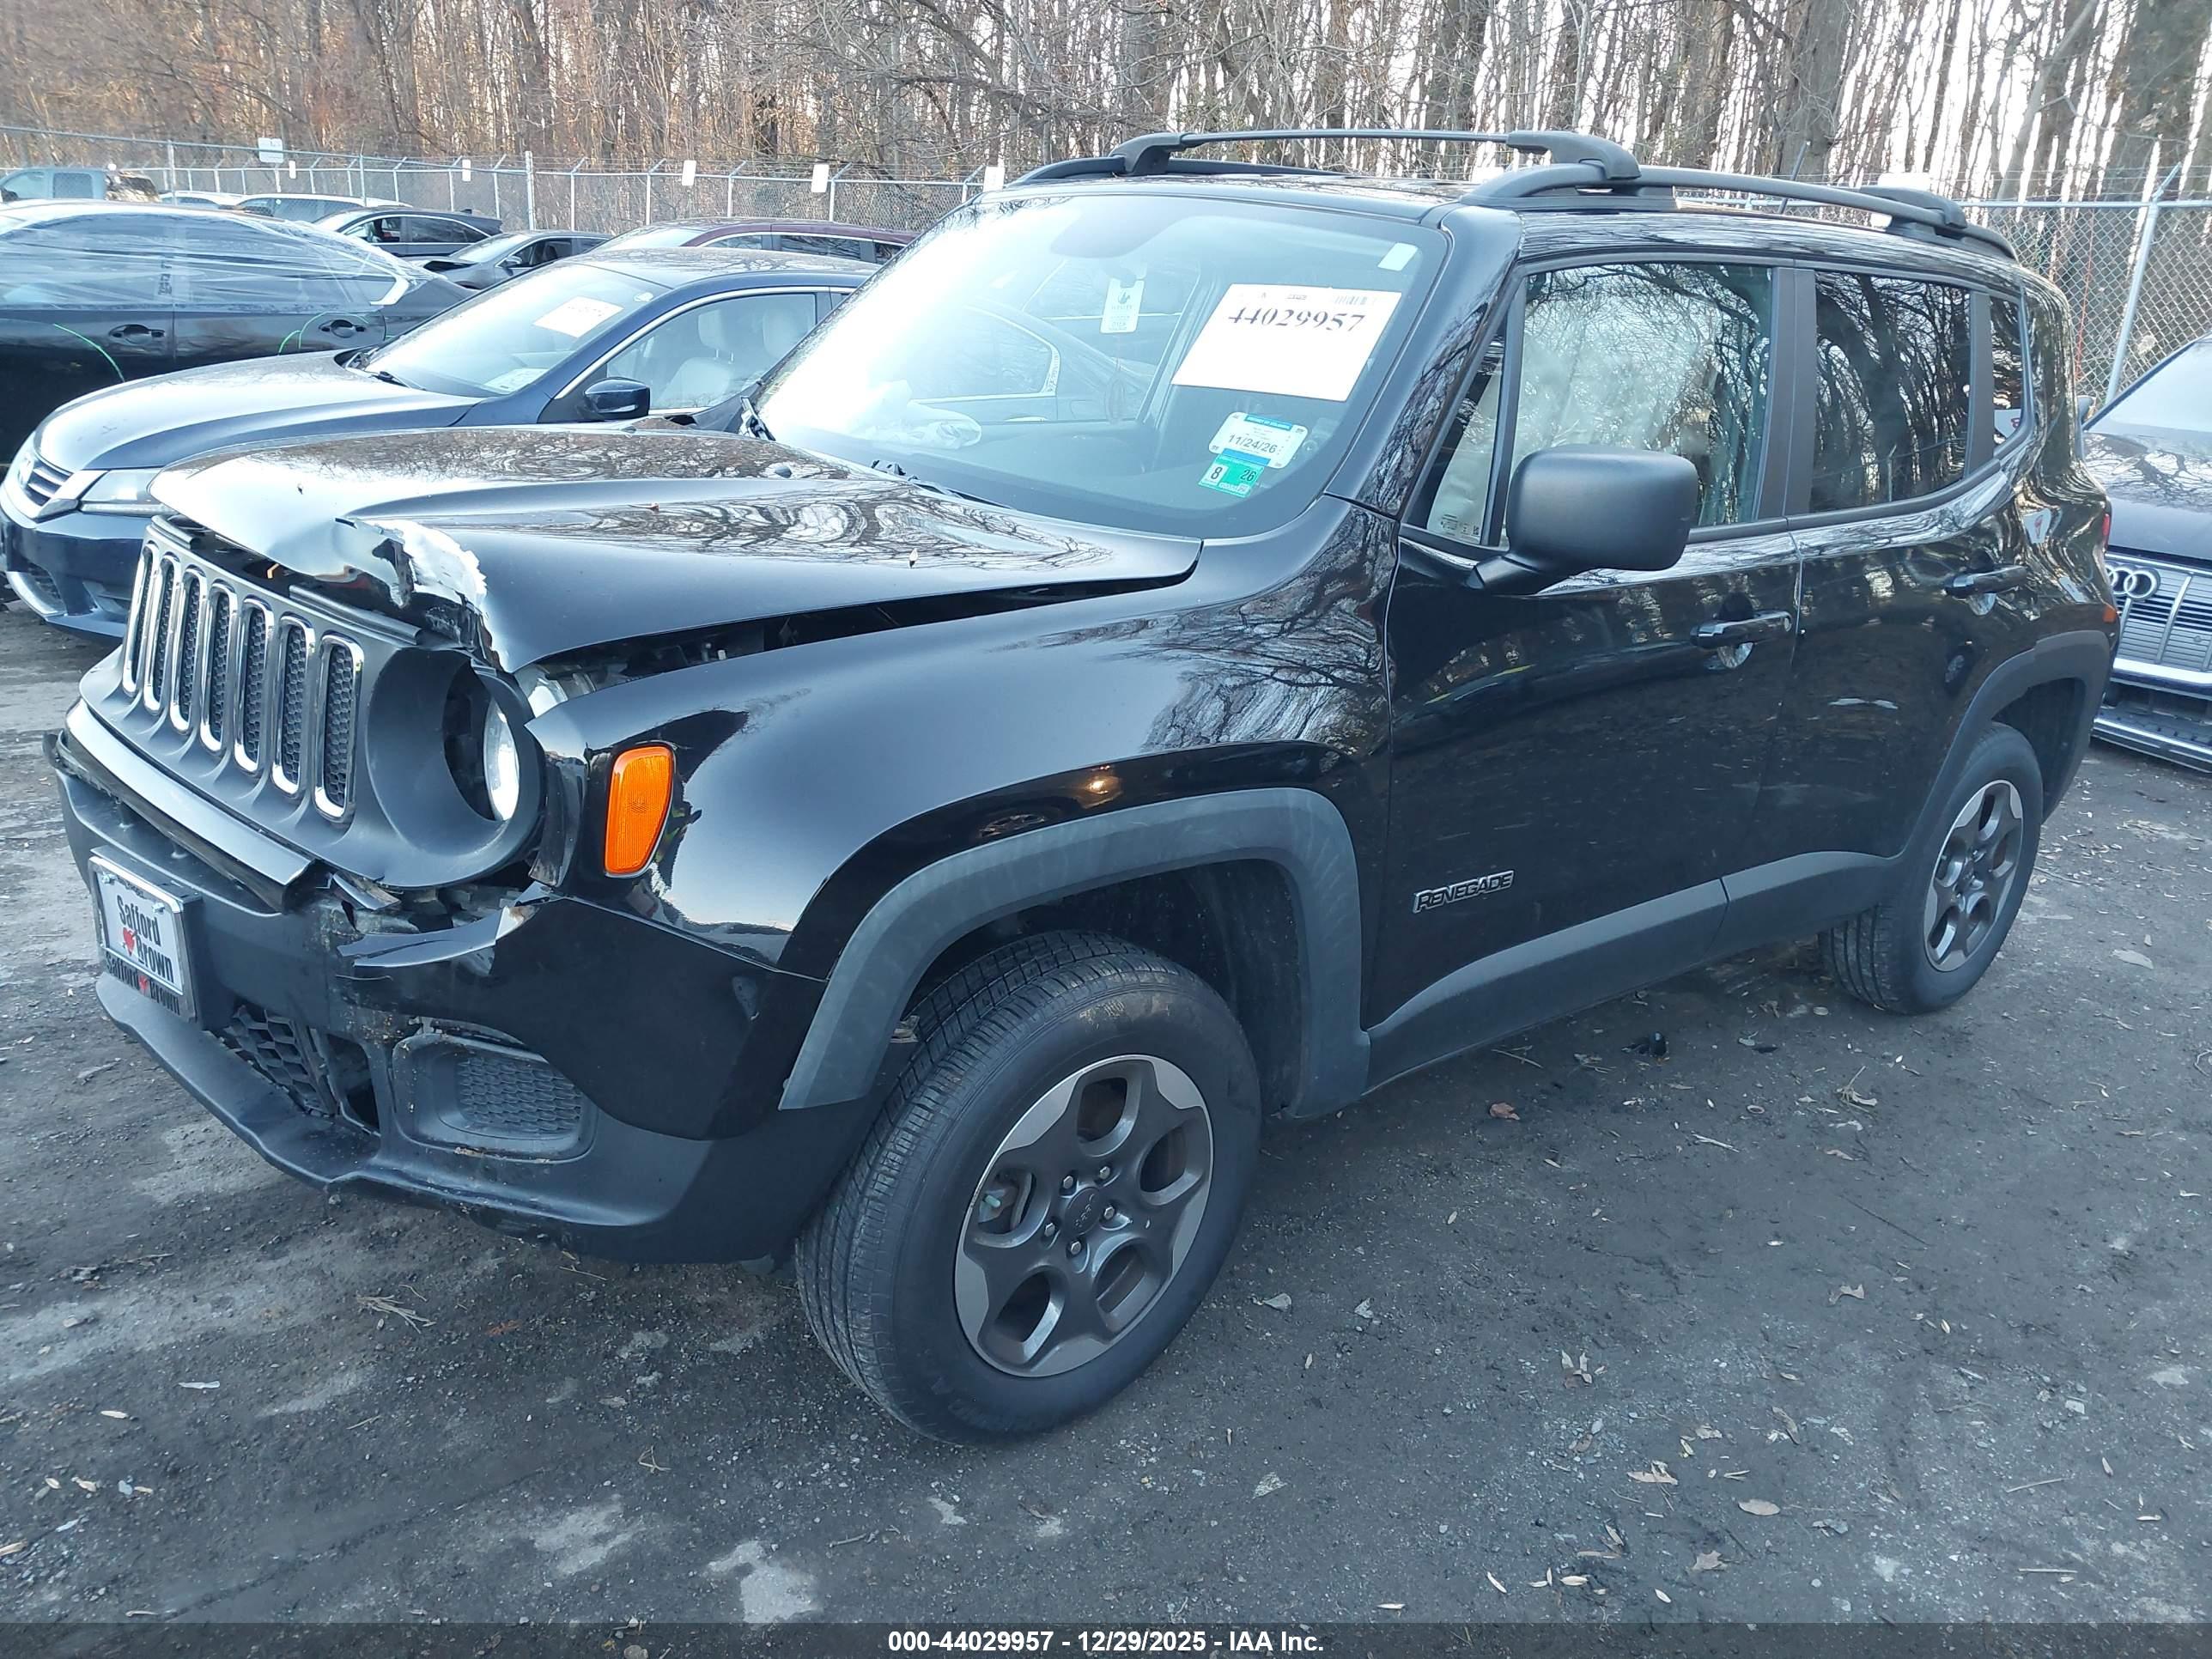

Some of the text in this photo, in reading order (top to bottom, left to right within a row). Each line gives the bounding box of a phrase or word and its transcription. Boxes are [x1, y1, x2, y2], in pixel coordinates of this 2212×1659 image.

[1228, 307, 1365, 331] 44029957
[1228, 434, 1278, 453] 11/24/26
[1211, 466, 1256, 482] 8 26
[1413, 870, 1514, 914] RENEGADE
[117, 895, 161, 946] Safford
[106, 952, 139, 990] Safford
[136, 935, 173, 983] Brown
[149, 977, 179, 1015] Brown
